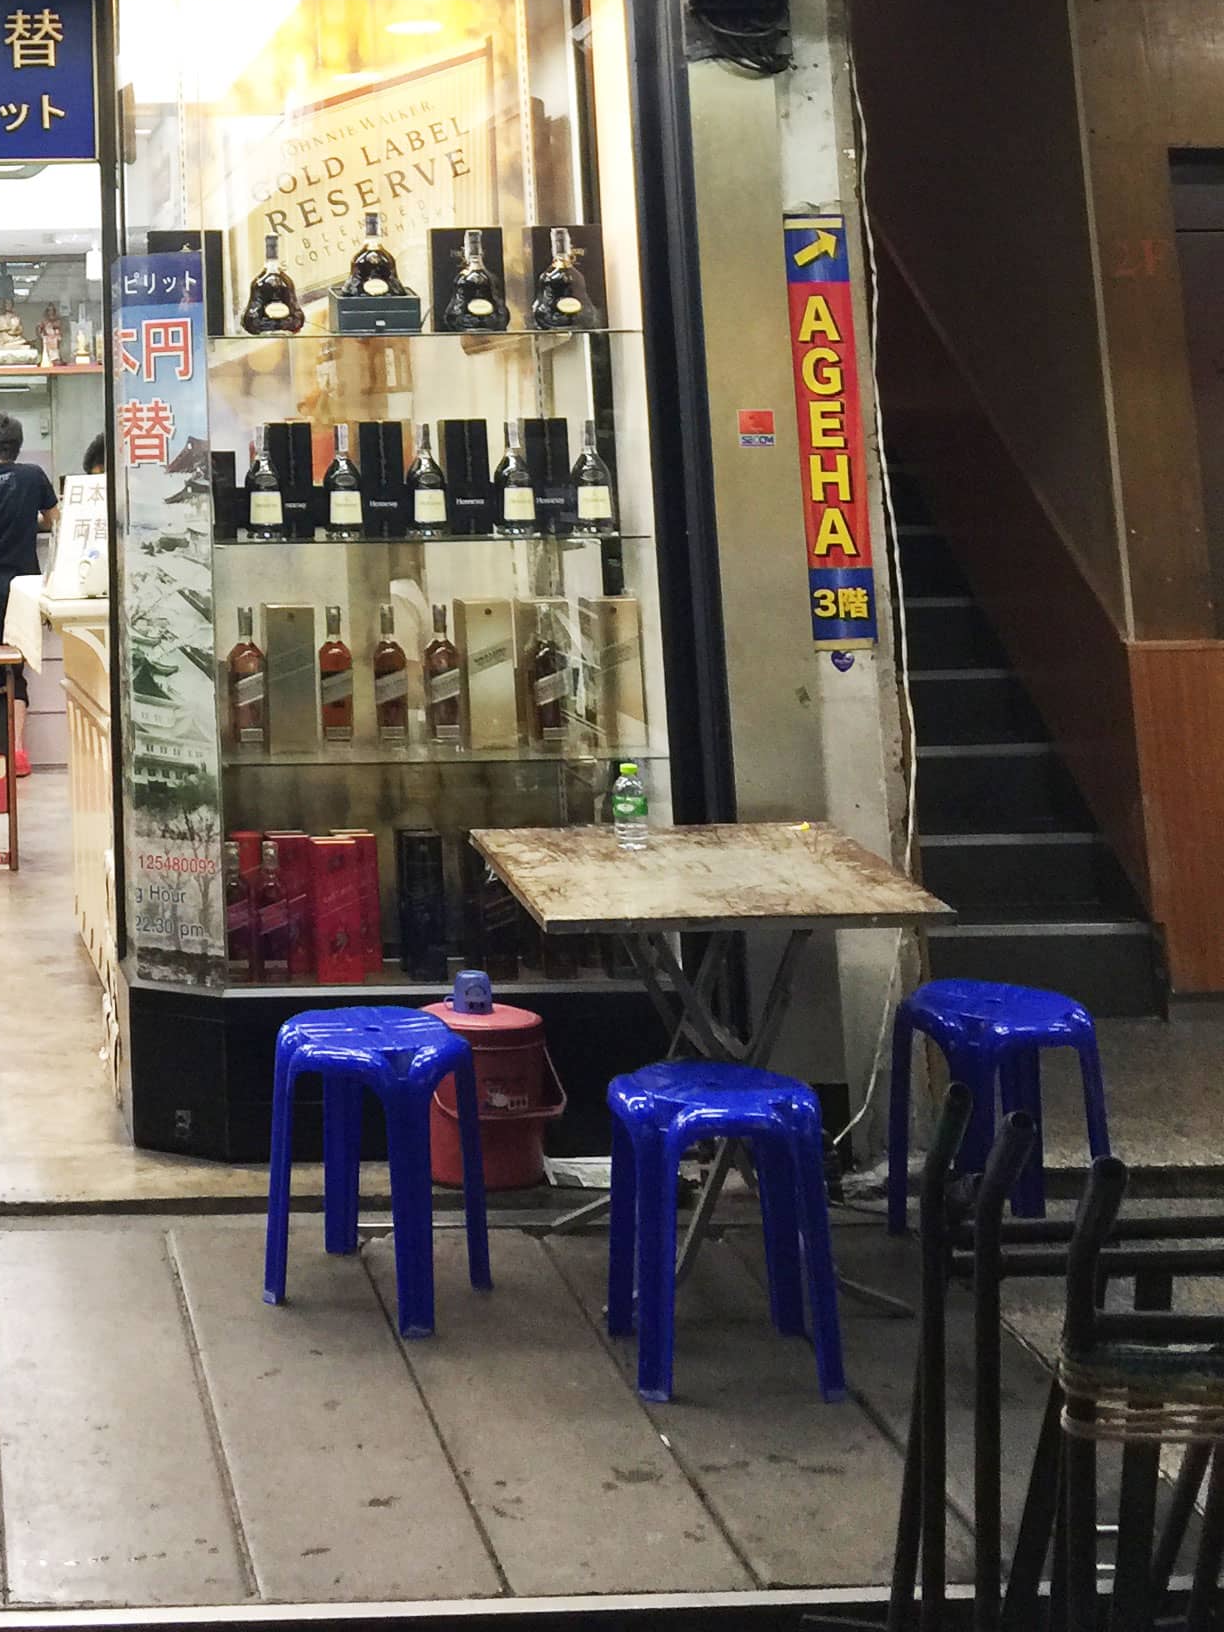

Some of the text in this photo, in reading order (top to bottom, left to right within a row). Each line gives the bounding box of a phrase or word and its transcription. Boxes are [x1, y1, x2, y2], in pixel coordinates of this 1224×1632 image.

[251, 115, 470, 203] GOLD LABEL
[264, 147, 472, 239] RESERVE
[797, 294, 858, 557] AGEHA
[813, 587, 869, 618] 3階
[138, 854, 217, 875] 125480093
[149, 884, 187, 904] Hour
